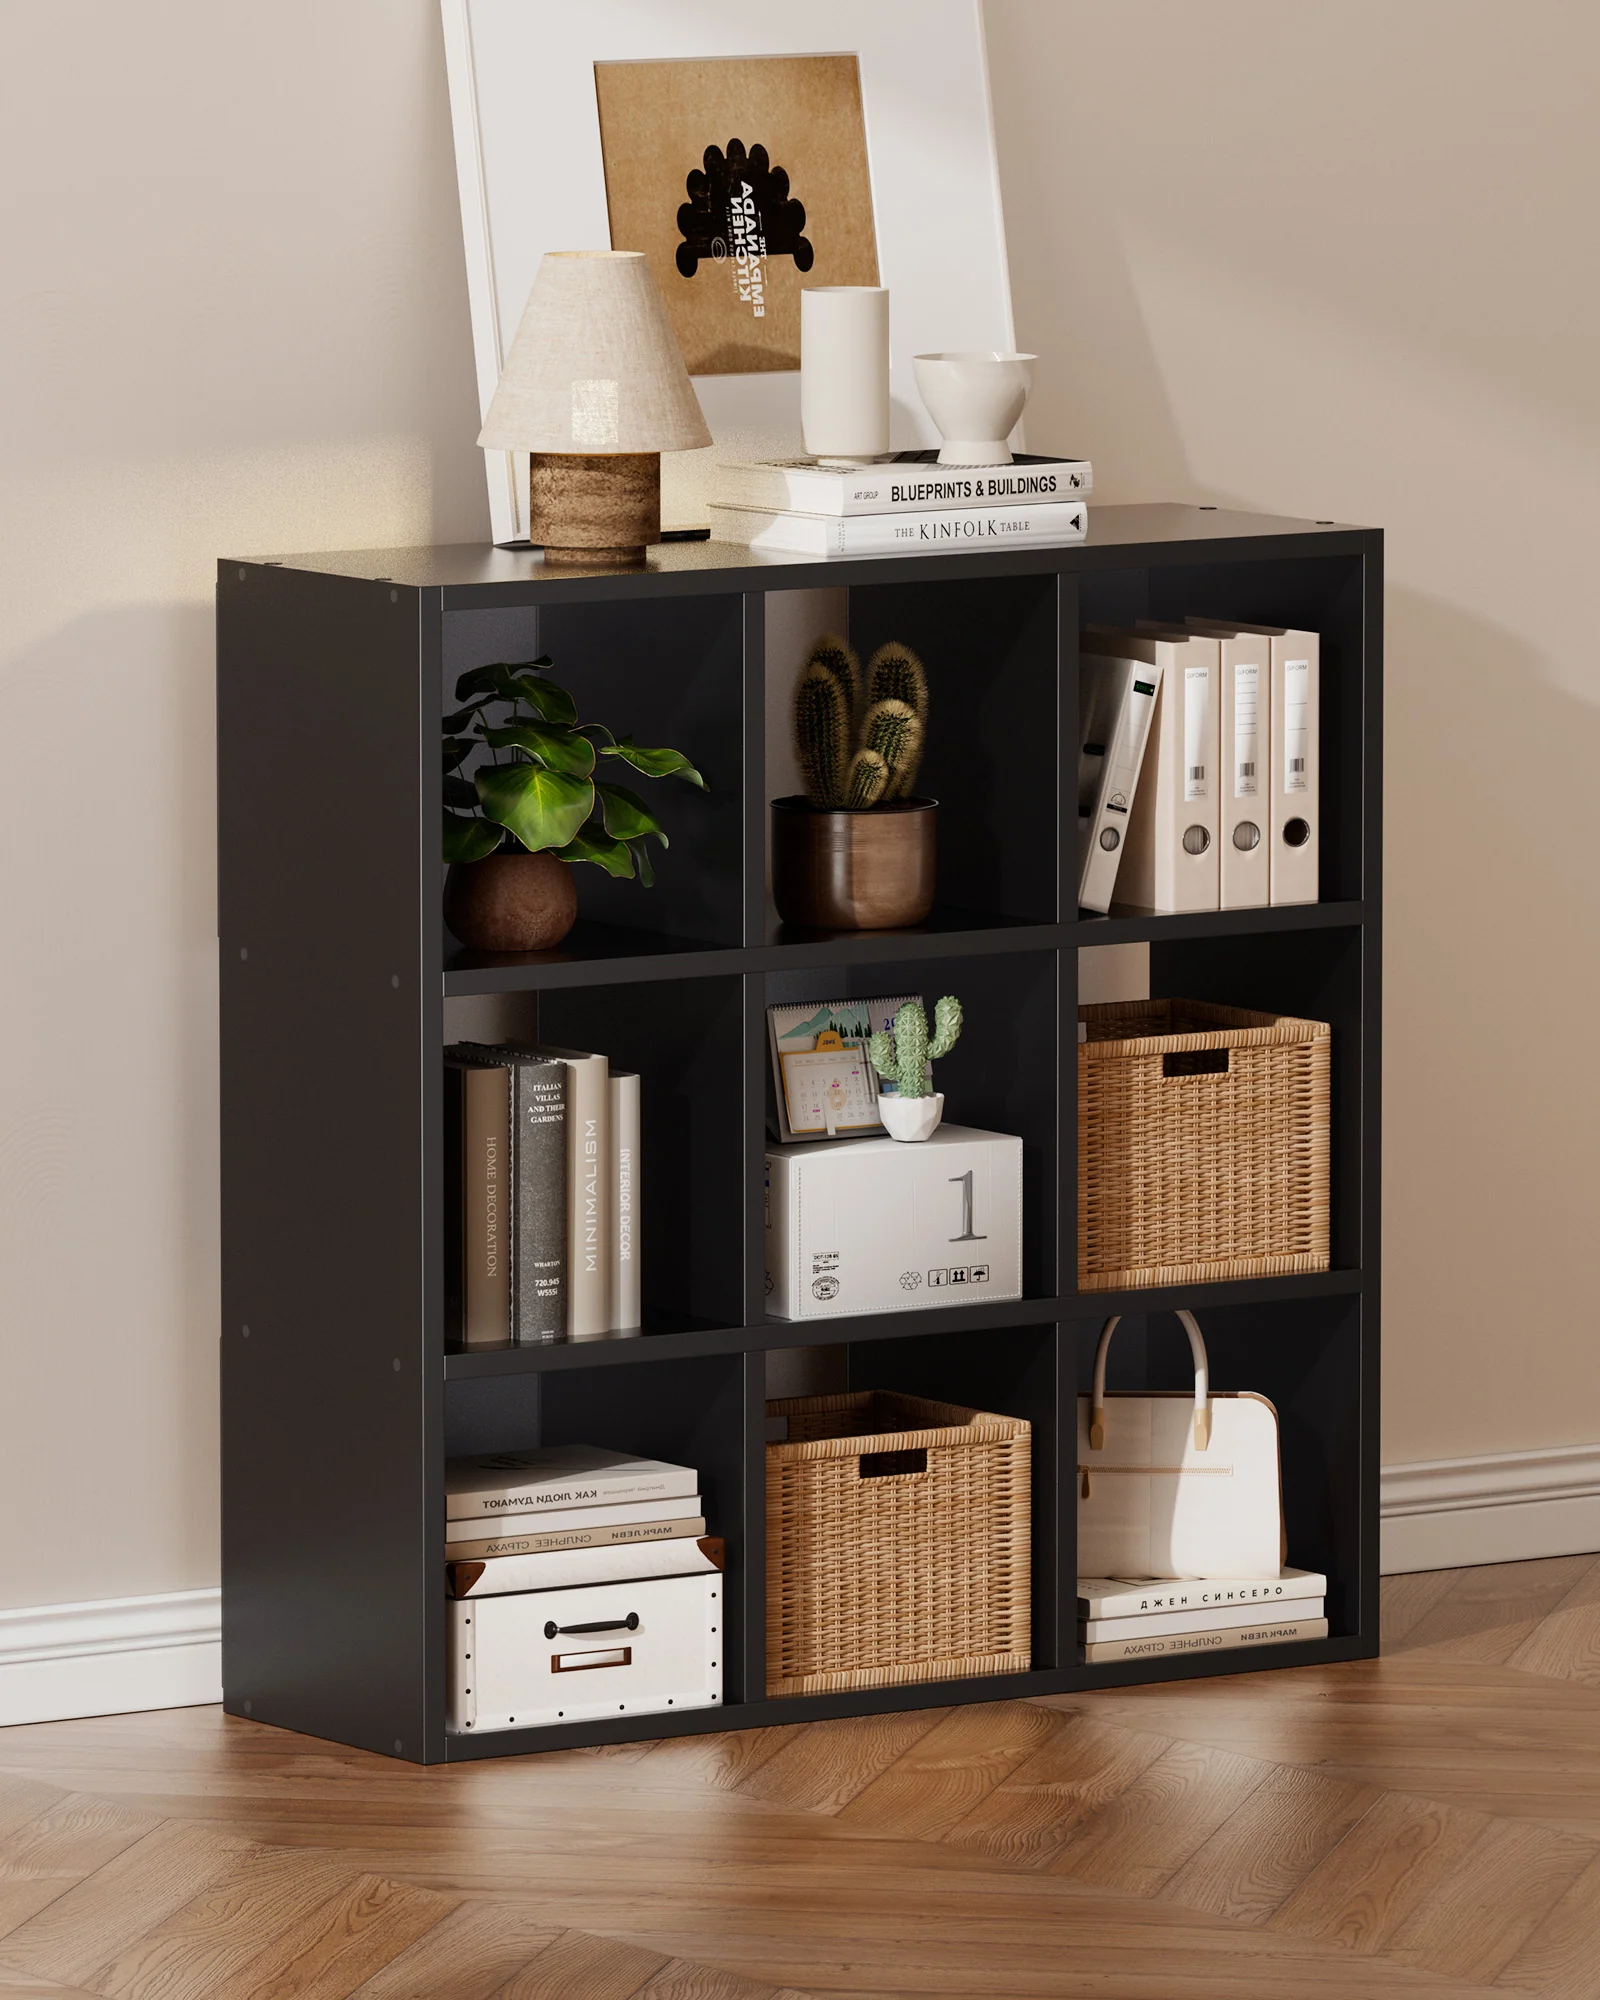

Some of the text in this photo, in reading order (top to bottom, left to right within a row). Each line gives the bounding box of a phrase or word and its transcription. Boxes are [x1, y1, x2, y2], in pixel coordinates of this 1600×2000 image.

[854, 490, 879, 500] ART GROUP
[891, 480, 971, 502] BLUEPRINTS
[975, 482, 985, 496] &
[988, 475, 1057, 496] BUILDINGS
[894, 519, 1030, 540] THE KINFOLK TABLE
[533, 1082, 562, 1092] ITALIAN
[535, 1093, 561, 1102] VILLAS
[528, 1103, 565, 1113] AND THEIR
[530, 1114, 564, 1124] GARDENS
[585, 1119, 597, 1272] MINIMALISM
[486, 1136, 497, 1278] HOME DECORATION
[620, 1148, 631, 1261] INTERIOR DECOR
[948, 1169, 988, 1242] 1
[534, 1260, 561, 1268] WHARTON
[534, 1278, 560, 1288] 720.945
[1140, 1586, 1283, 1610] ДЖЕН СИНСЕРО
